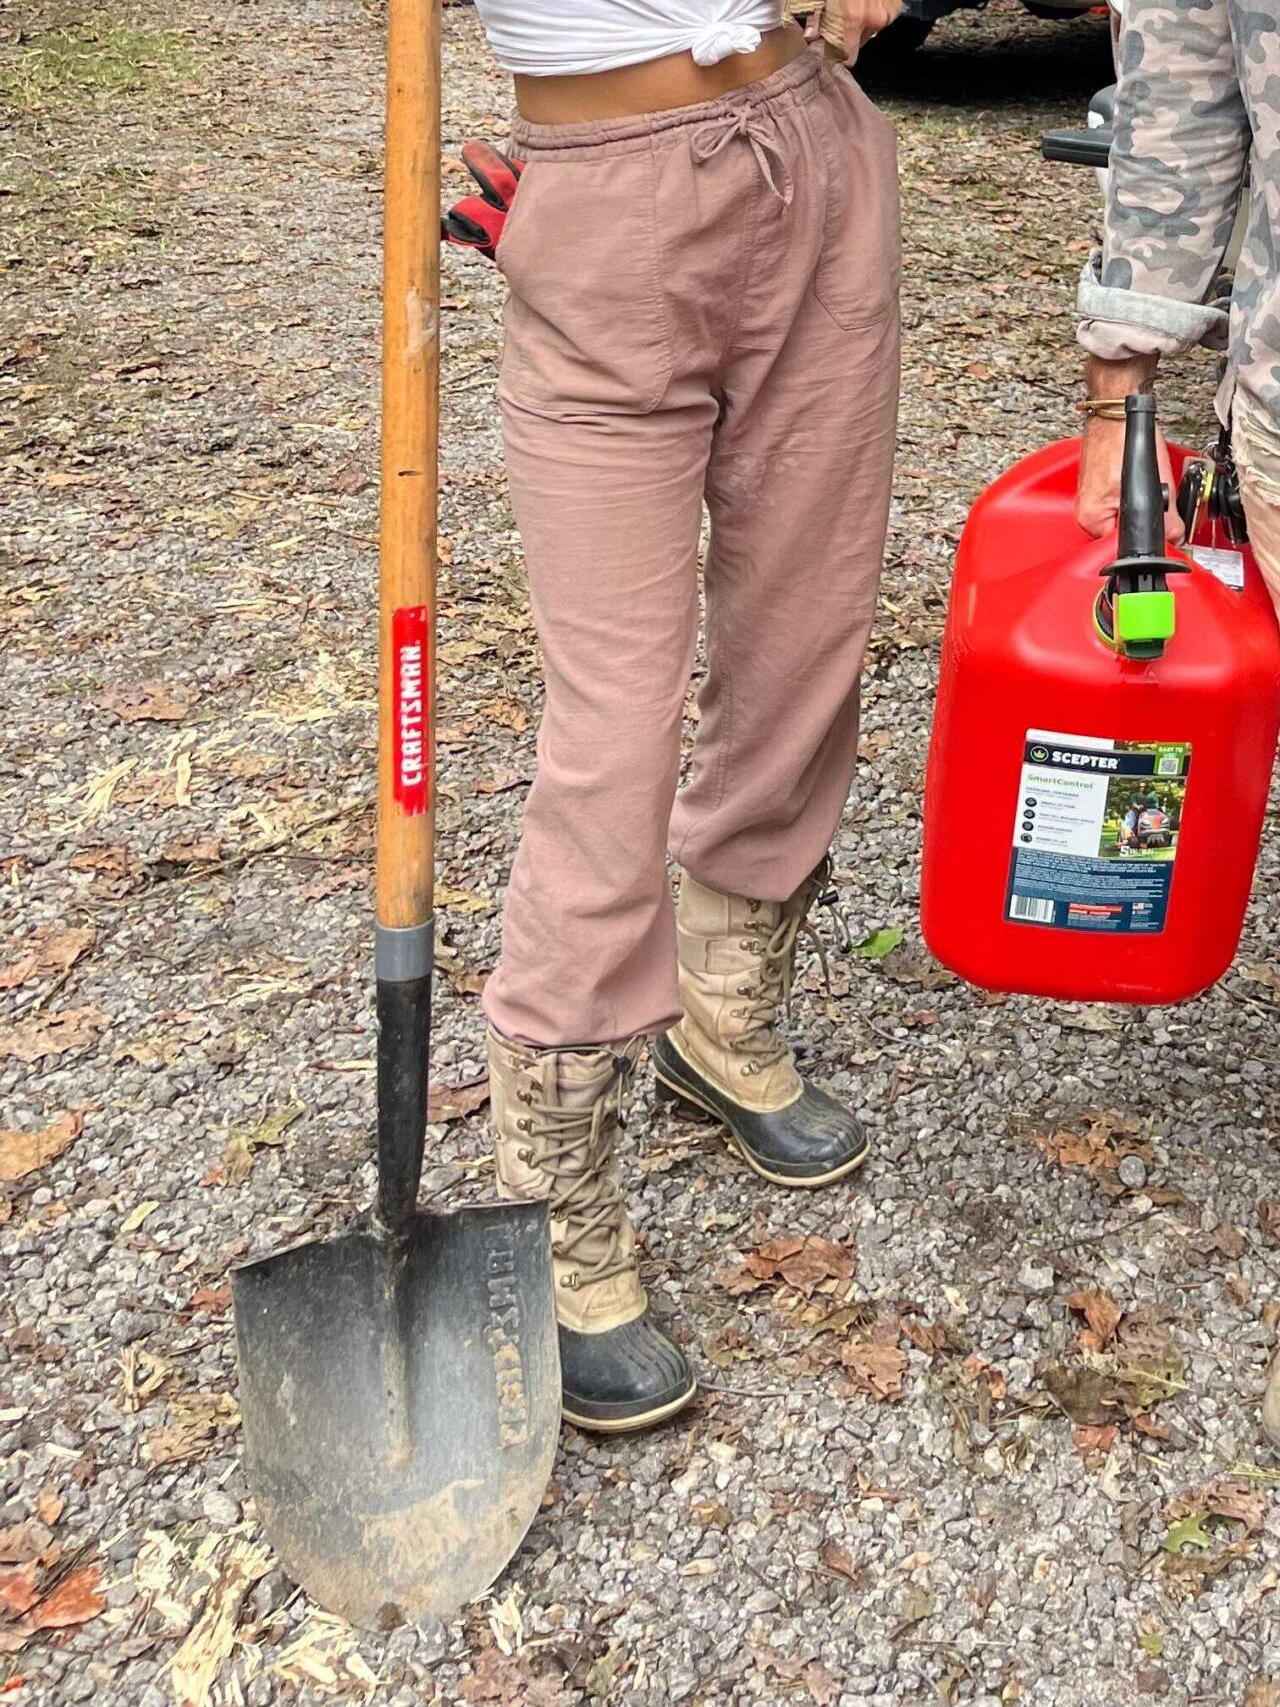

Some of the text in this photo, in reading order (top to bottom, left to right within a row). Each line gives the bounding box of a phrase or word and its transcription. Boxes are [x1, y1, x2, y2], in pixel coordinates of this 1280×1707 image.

[401, 646, 422, 786] CRAFTSMAN
[1052, 750, 1119, 771] SCEPTER
[1028, 774, 1094, 790] SmartControl
